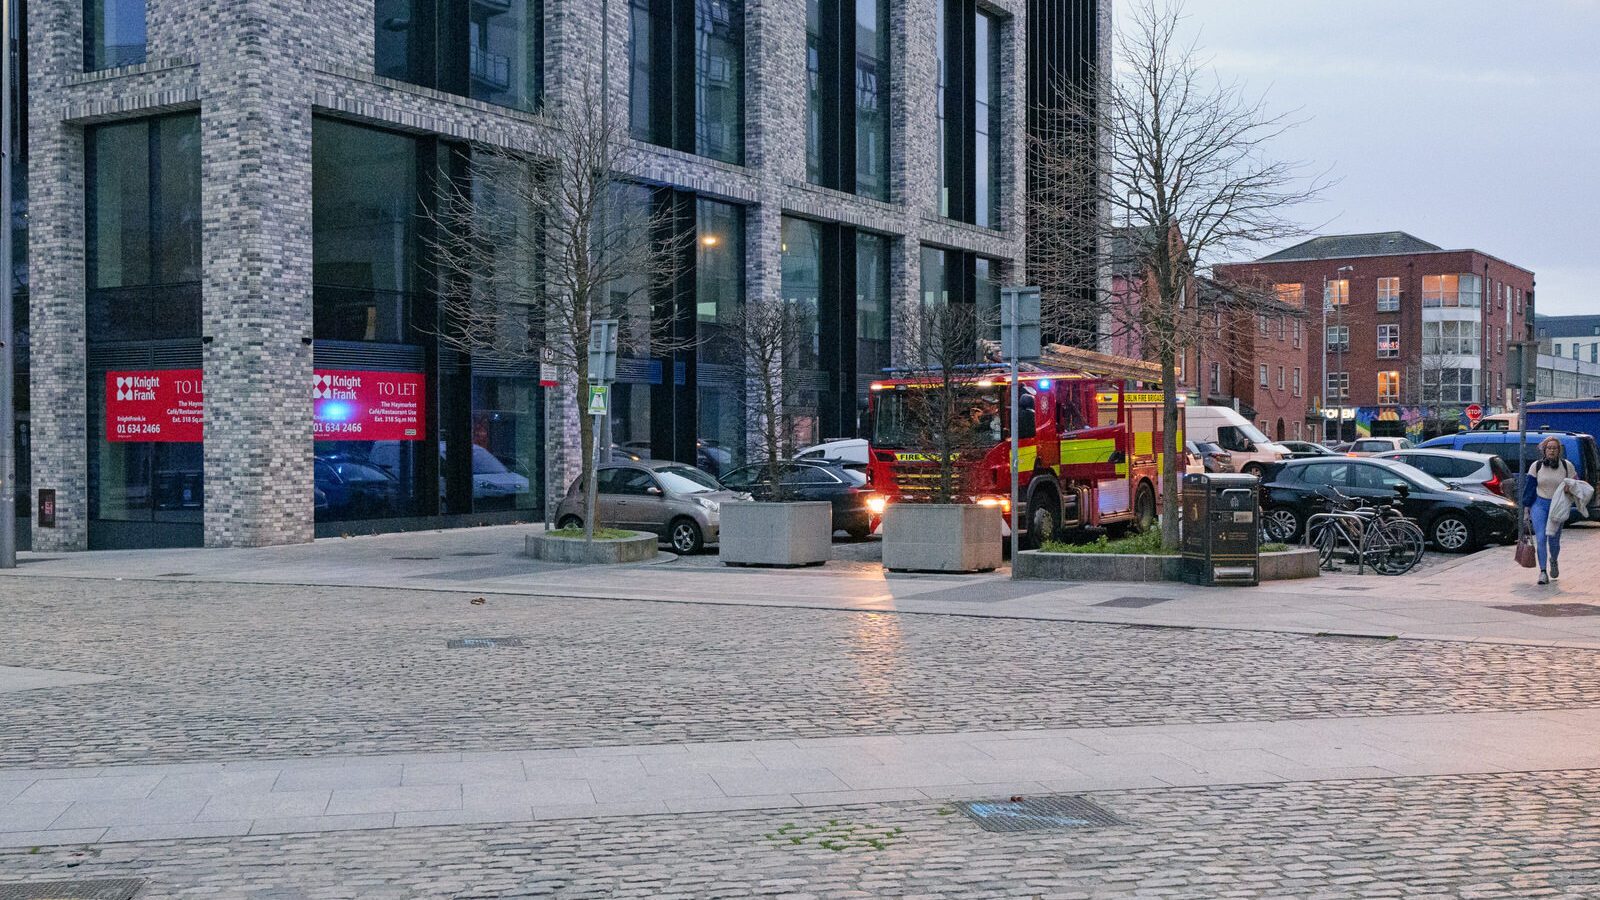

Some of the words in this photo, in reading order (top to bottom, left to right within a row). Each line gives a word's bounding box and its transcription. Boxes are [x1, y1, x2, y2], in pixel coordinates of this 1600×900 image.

[134, 376, 159, 389] Knight
[175, 381, 191, 393] TO
[333, 376, 361, 389] Knight
[333, 389, 357, 399] Frank
[377, 382, 394, 395] TO
[398, 383, 417, 395] LET
[134, 390, 155, 400] Frank
[117, 424, 126, 433] 01
[128, 424, 140, 433] 634
[142, 424, 160, 433] 2466
[314, 423, 323, 432] 01
[326, 423, 340, 432] 634
[342, 423, 362, 432] 2466
